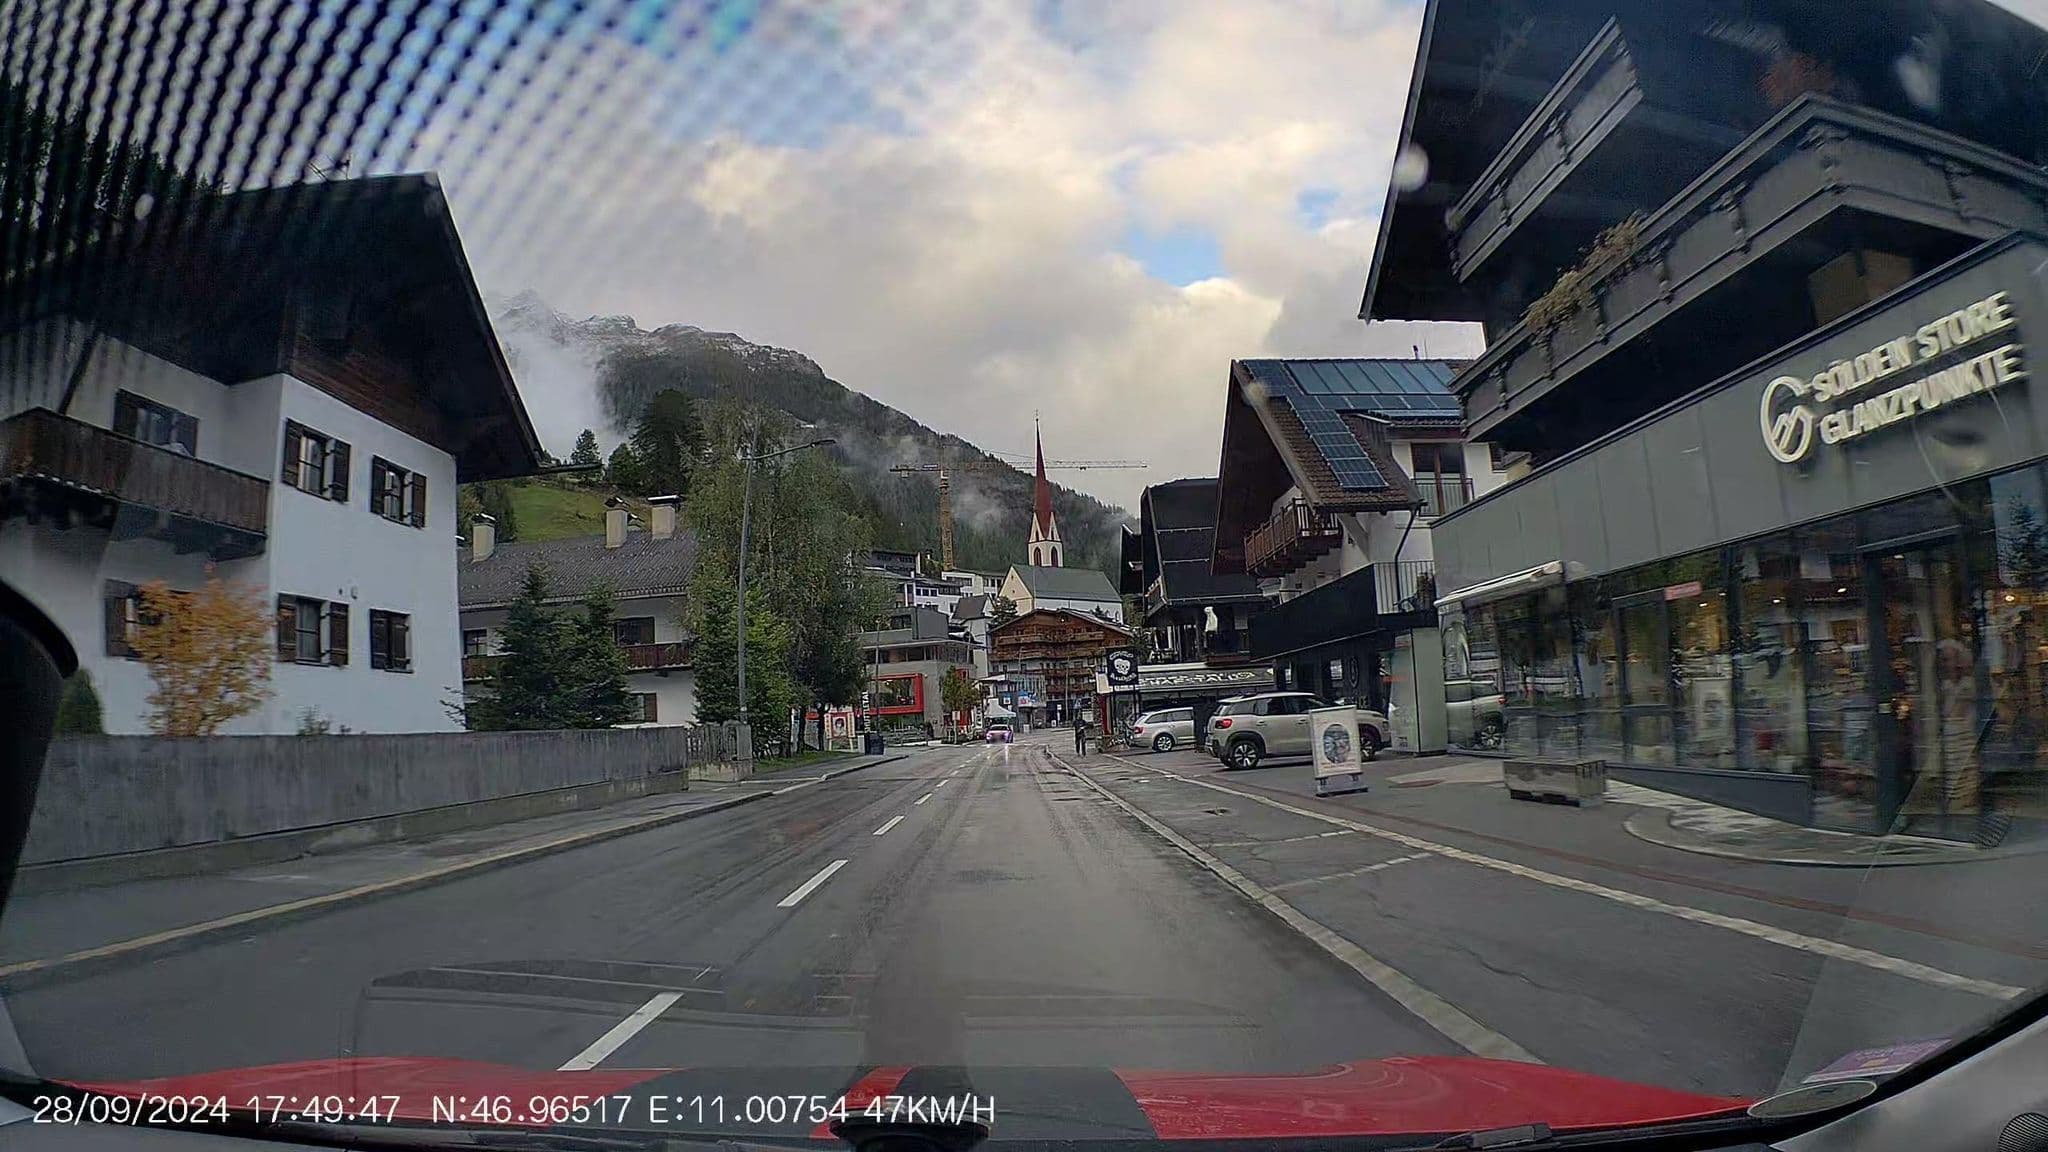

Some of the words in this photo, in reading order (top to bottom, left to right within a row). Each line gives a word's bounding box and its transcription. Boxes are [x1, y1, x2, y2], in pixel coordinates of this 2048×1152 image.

[1811, 335, 1913, 403] SÖLDEN
[1915, 290, 2018, 359] STORE
[1819, 344, 2030, 445] GLANZPUNKTE
